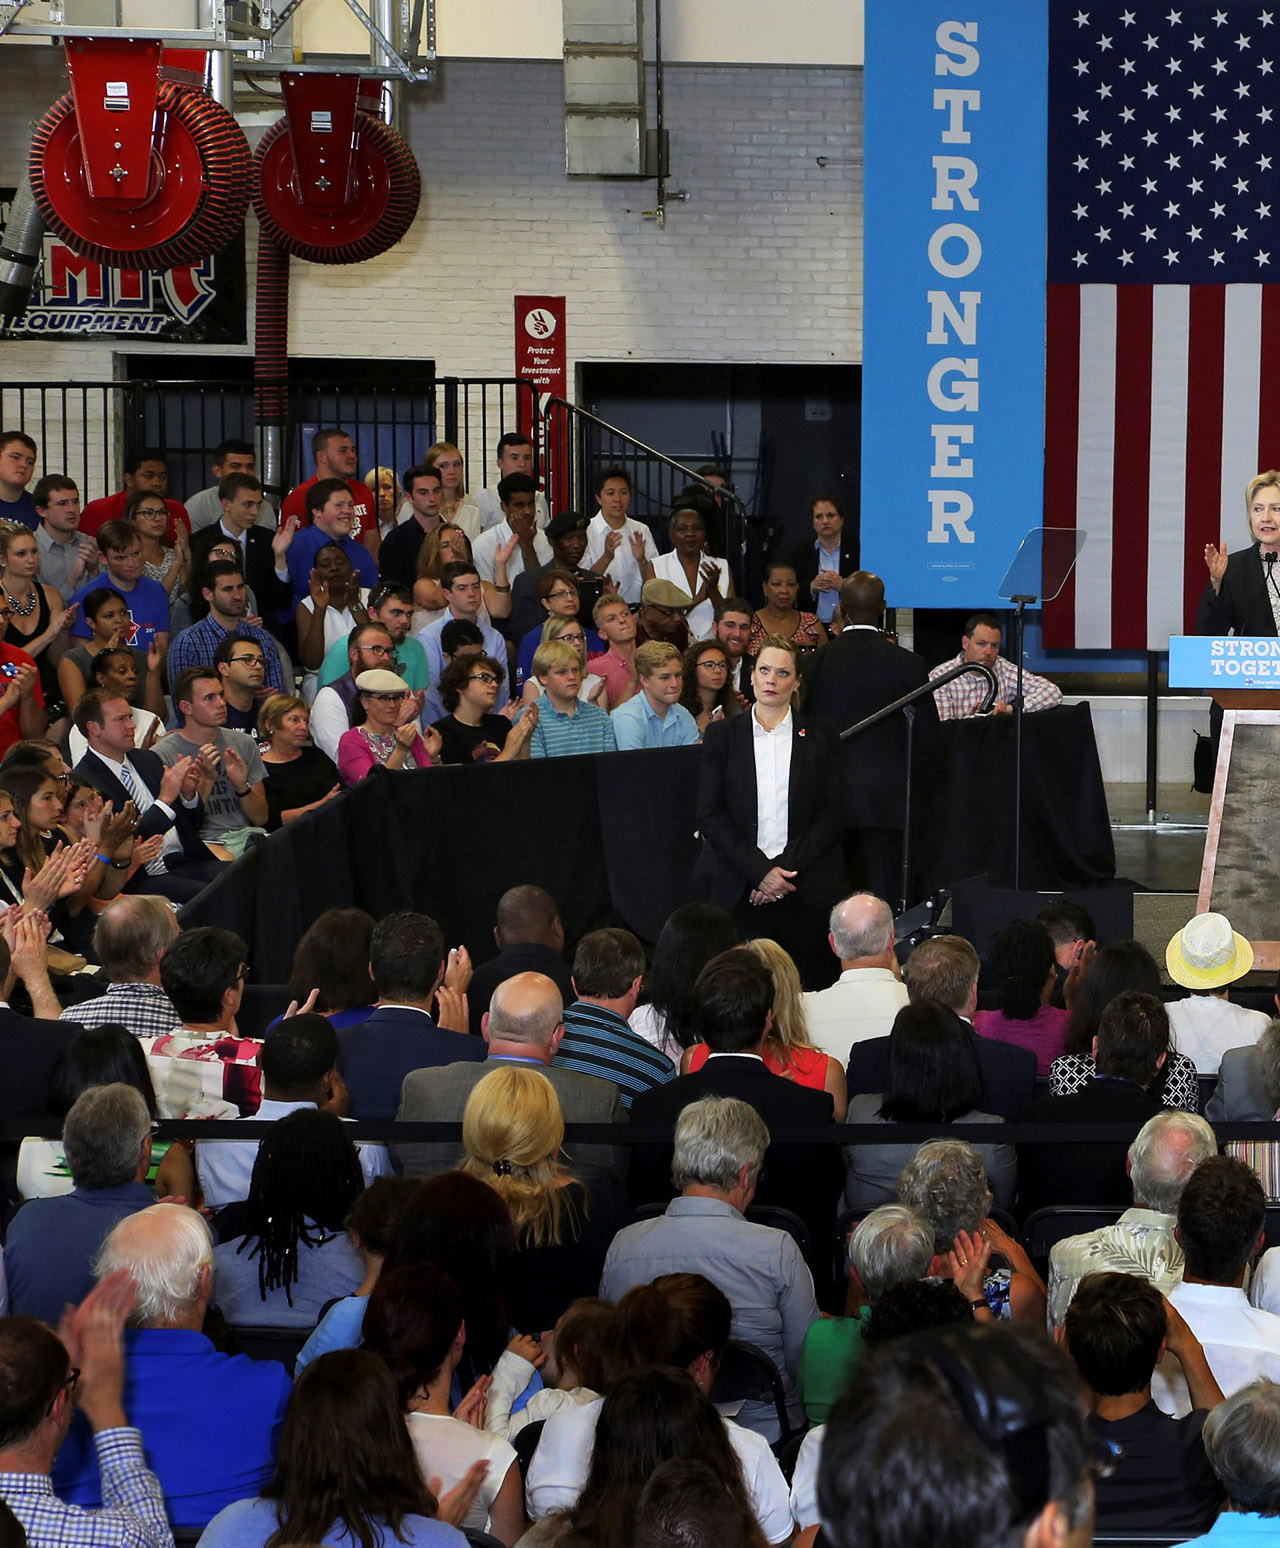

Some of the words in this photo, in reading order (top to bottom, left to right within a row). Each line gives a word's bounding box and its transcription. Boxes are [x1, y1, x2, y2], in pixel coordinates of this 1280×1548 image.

[927, 20, 981, 543] STRONGER
[13, 311, 166, 334] EQUIPMENT
[527, 346, 554, 354] Protect
[533, 357, 549, 365] Your
[521, 366, 561, 374] Investment
